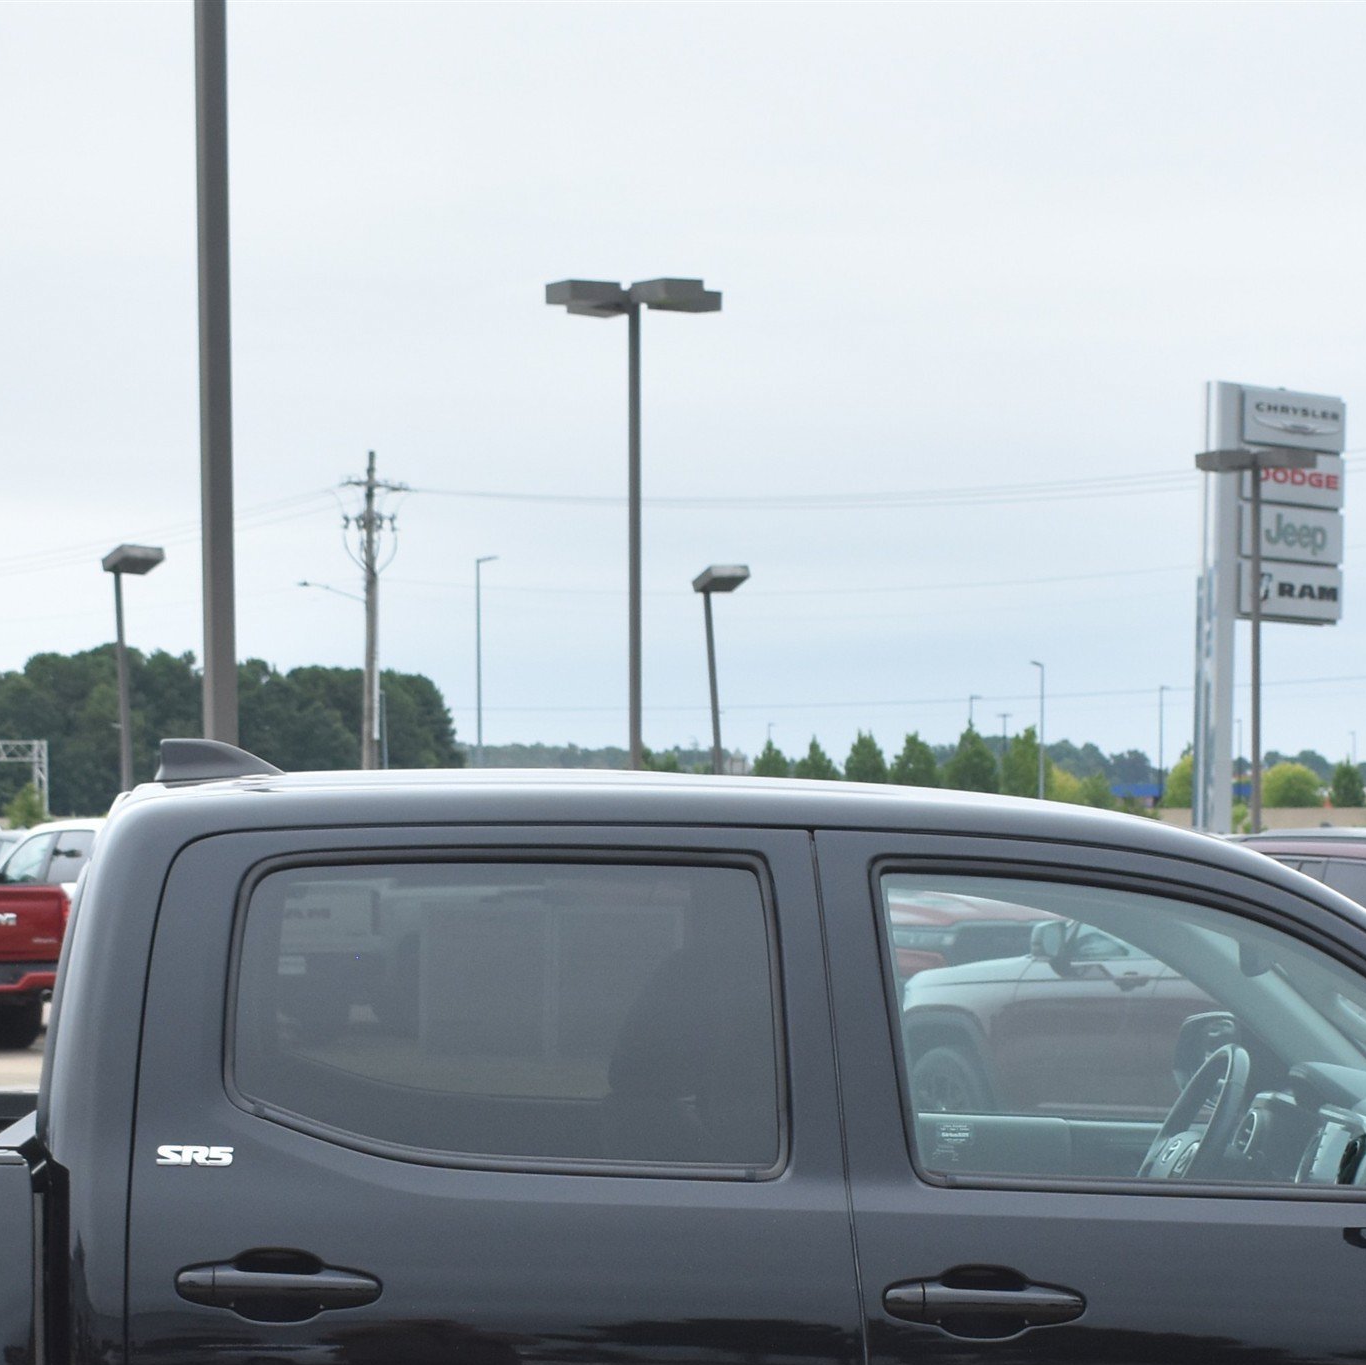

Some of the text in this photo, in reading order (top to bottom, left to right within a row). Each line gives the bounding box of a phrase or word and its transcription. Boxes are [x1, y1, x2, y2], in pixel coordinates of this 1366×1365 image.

[1255, 401, 1340, 421] CHRYSLER
[1265, 513, 1327, 555] Jeep
[1278, 582, 1339, 602] RAM
[156, 1144, 234, 1167] SR5
